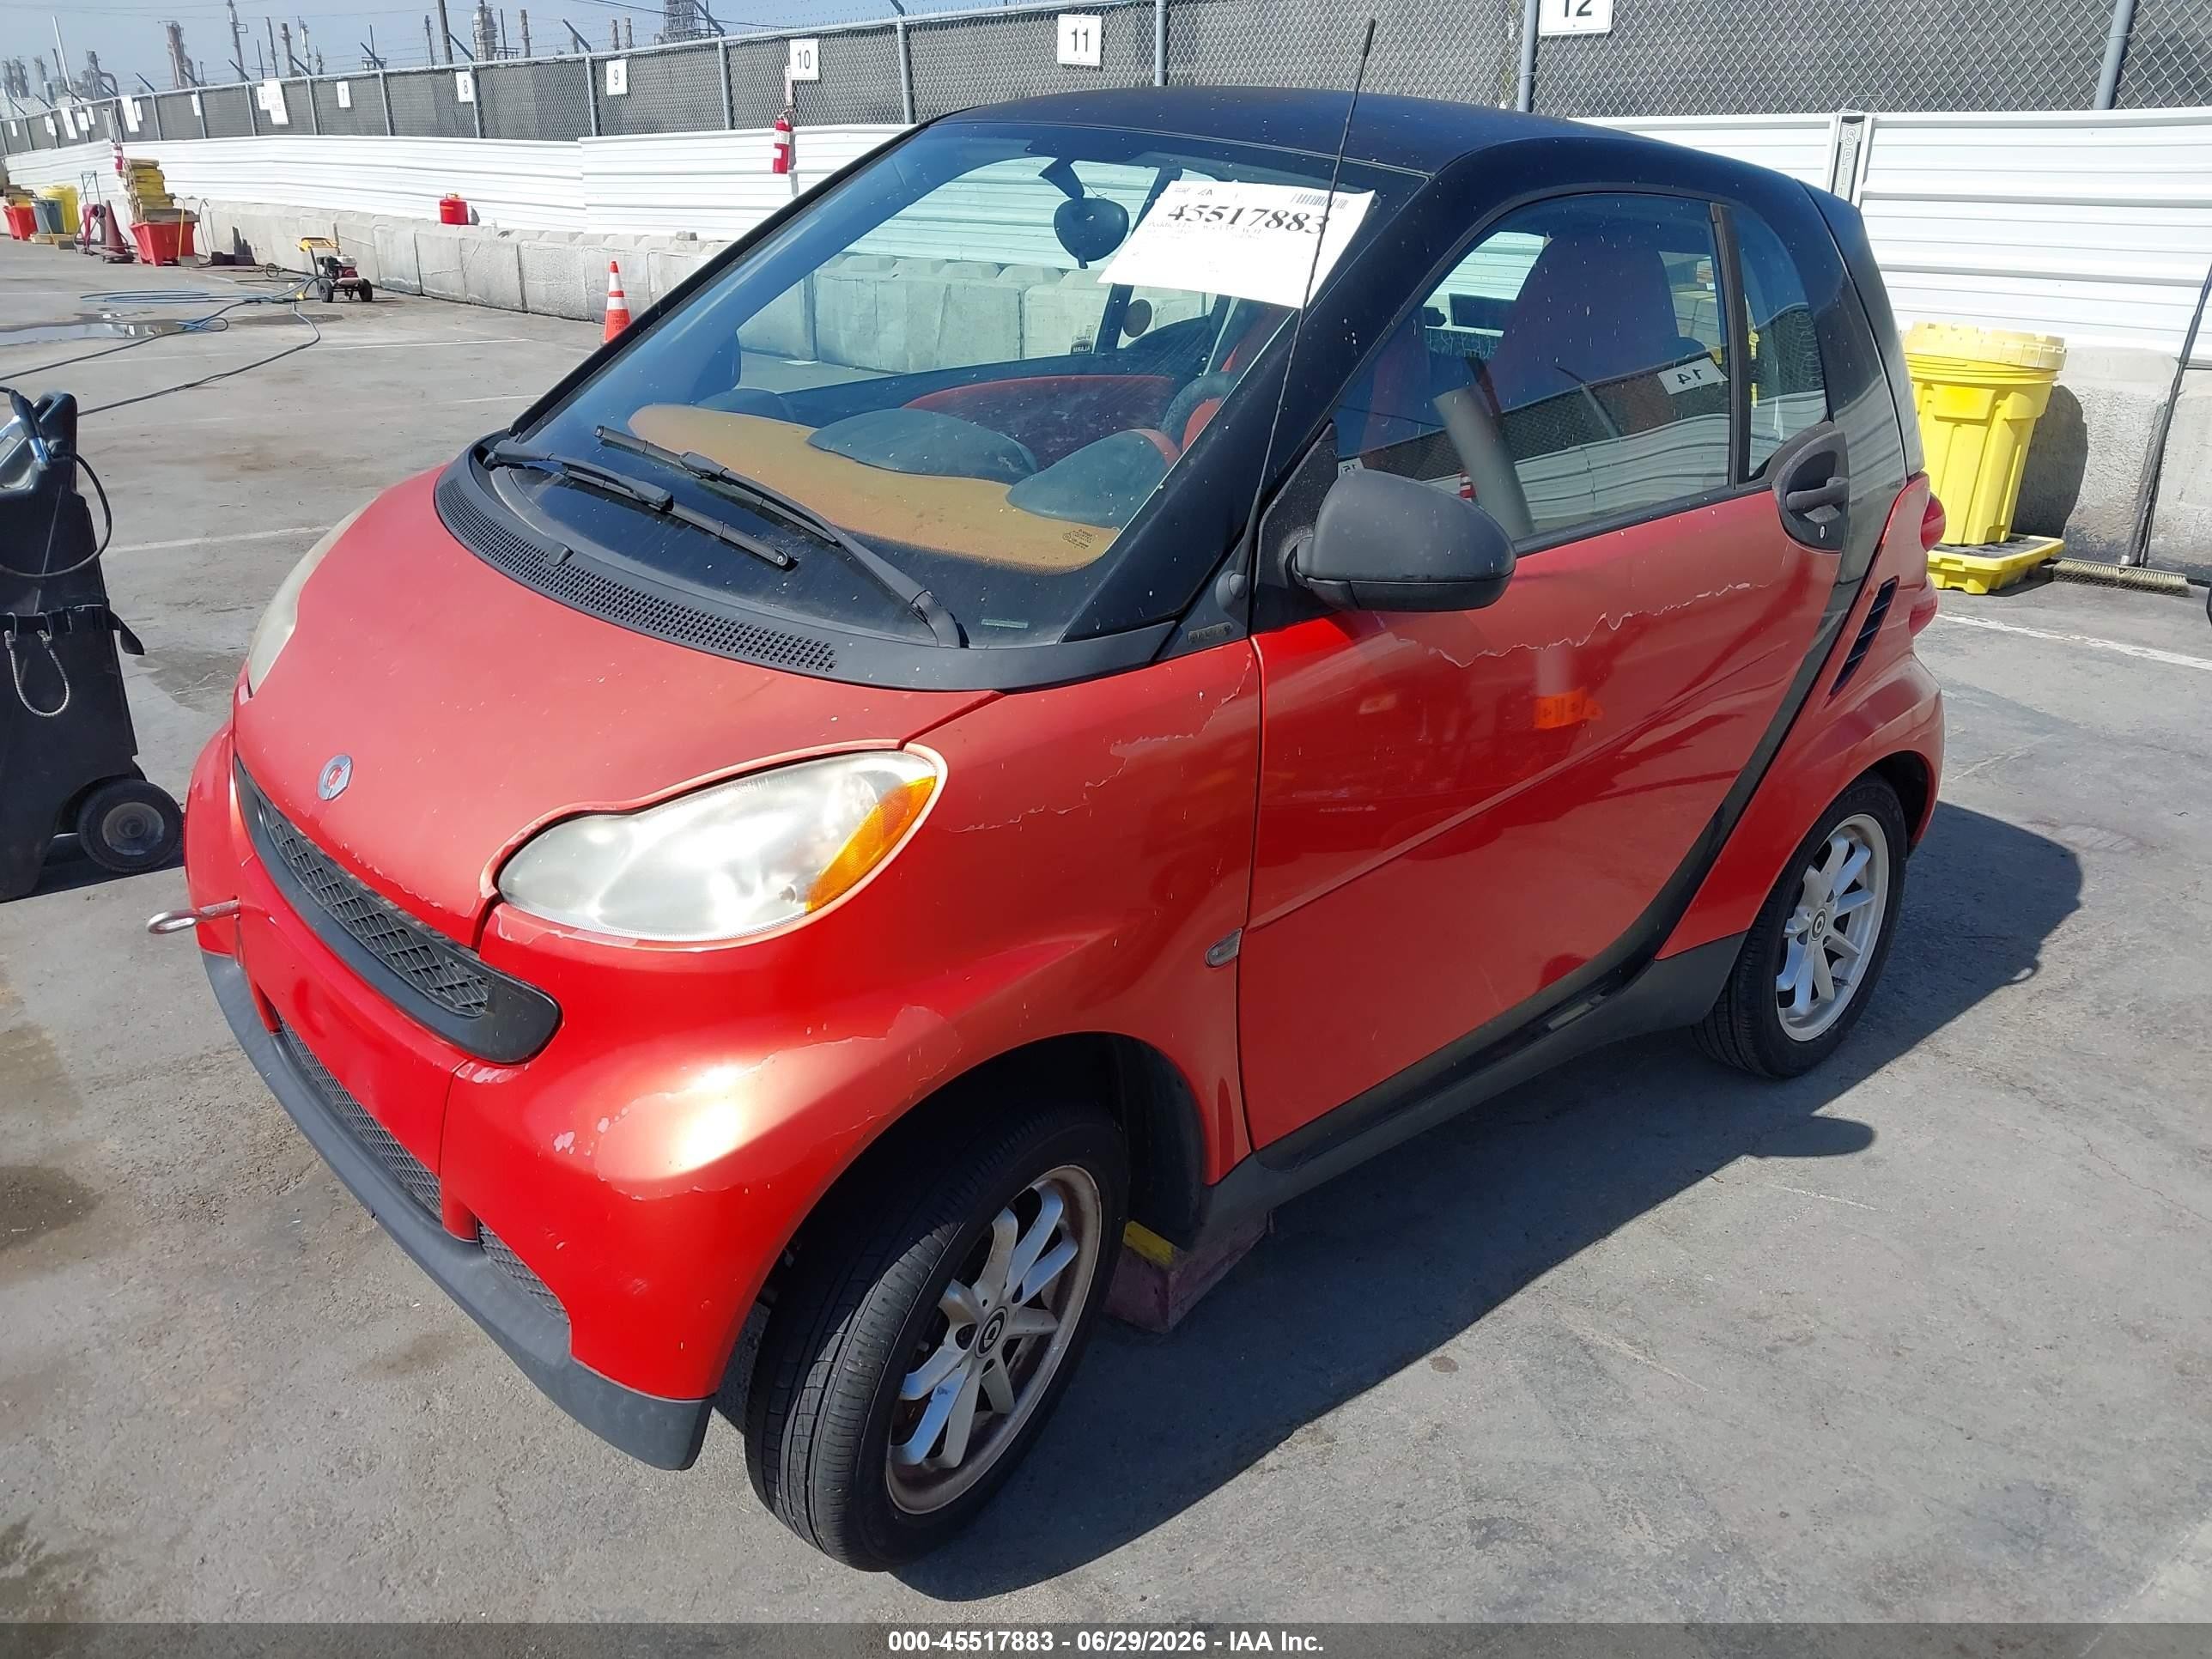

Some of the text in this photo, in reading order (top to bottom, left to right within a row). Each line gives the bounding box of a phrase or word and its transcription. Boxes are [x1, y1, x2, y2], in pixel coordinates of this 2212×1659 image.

[1563, 0, 1593, 17] 12
[1071, 27, 1089, 52] 11
[796, 49, 811, 70] 10
[463, 79, 469, 94] 8
[613, 69, 619, 86] 9
[1837, 128, 1856, 197] SPI
[1167, 204, 1330, 234] 45517883
